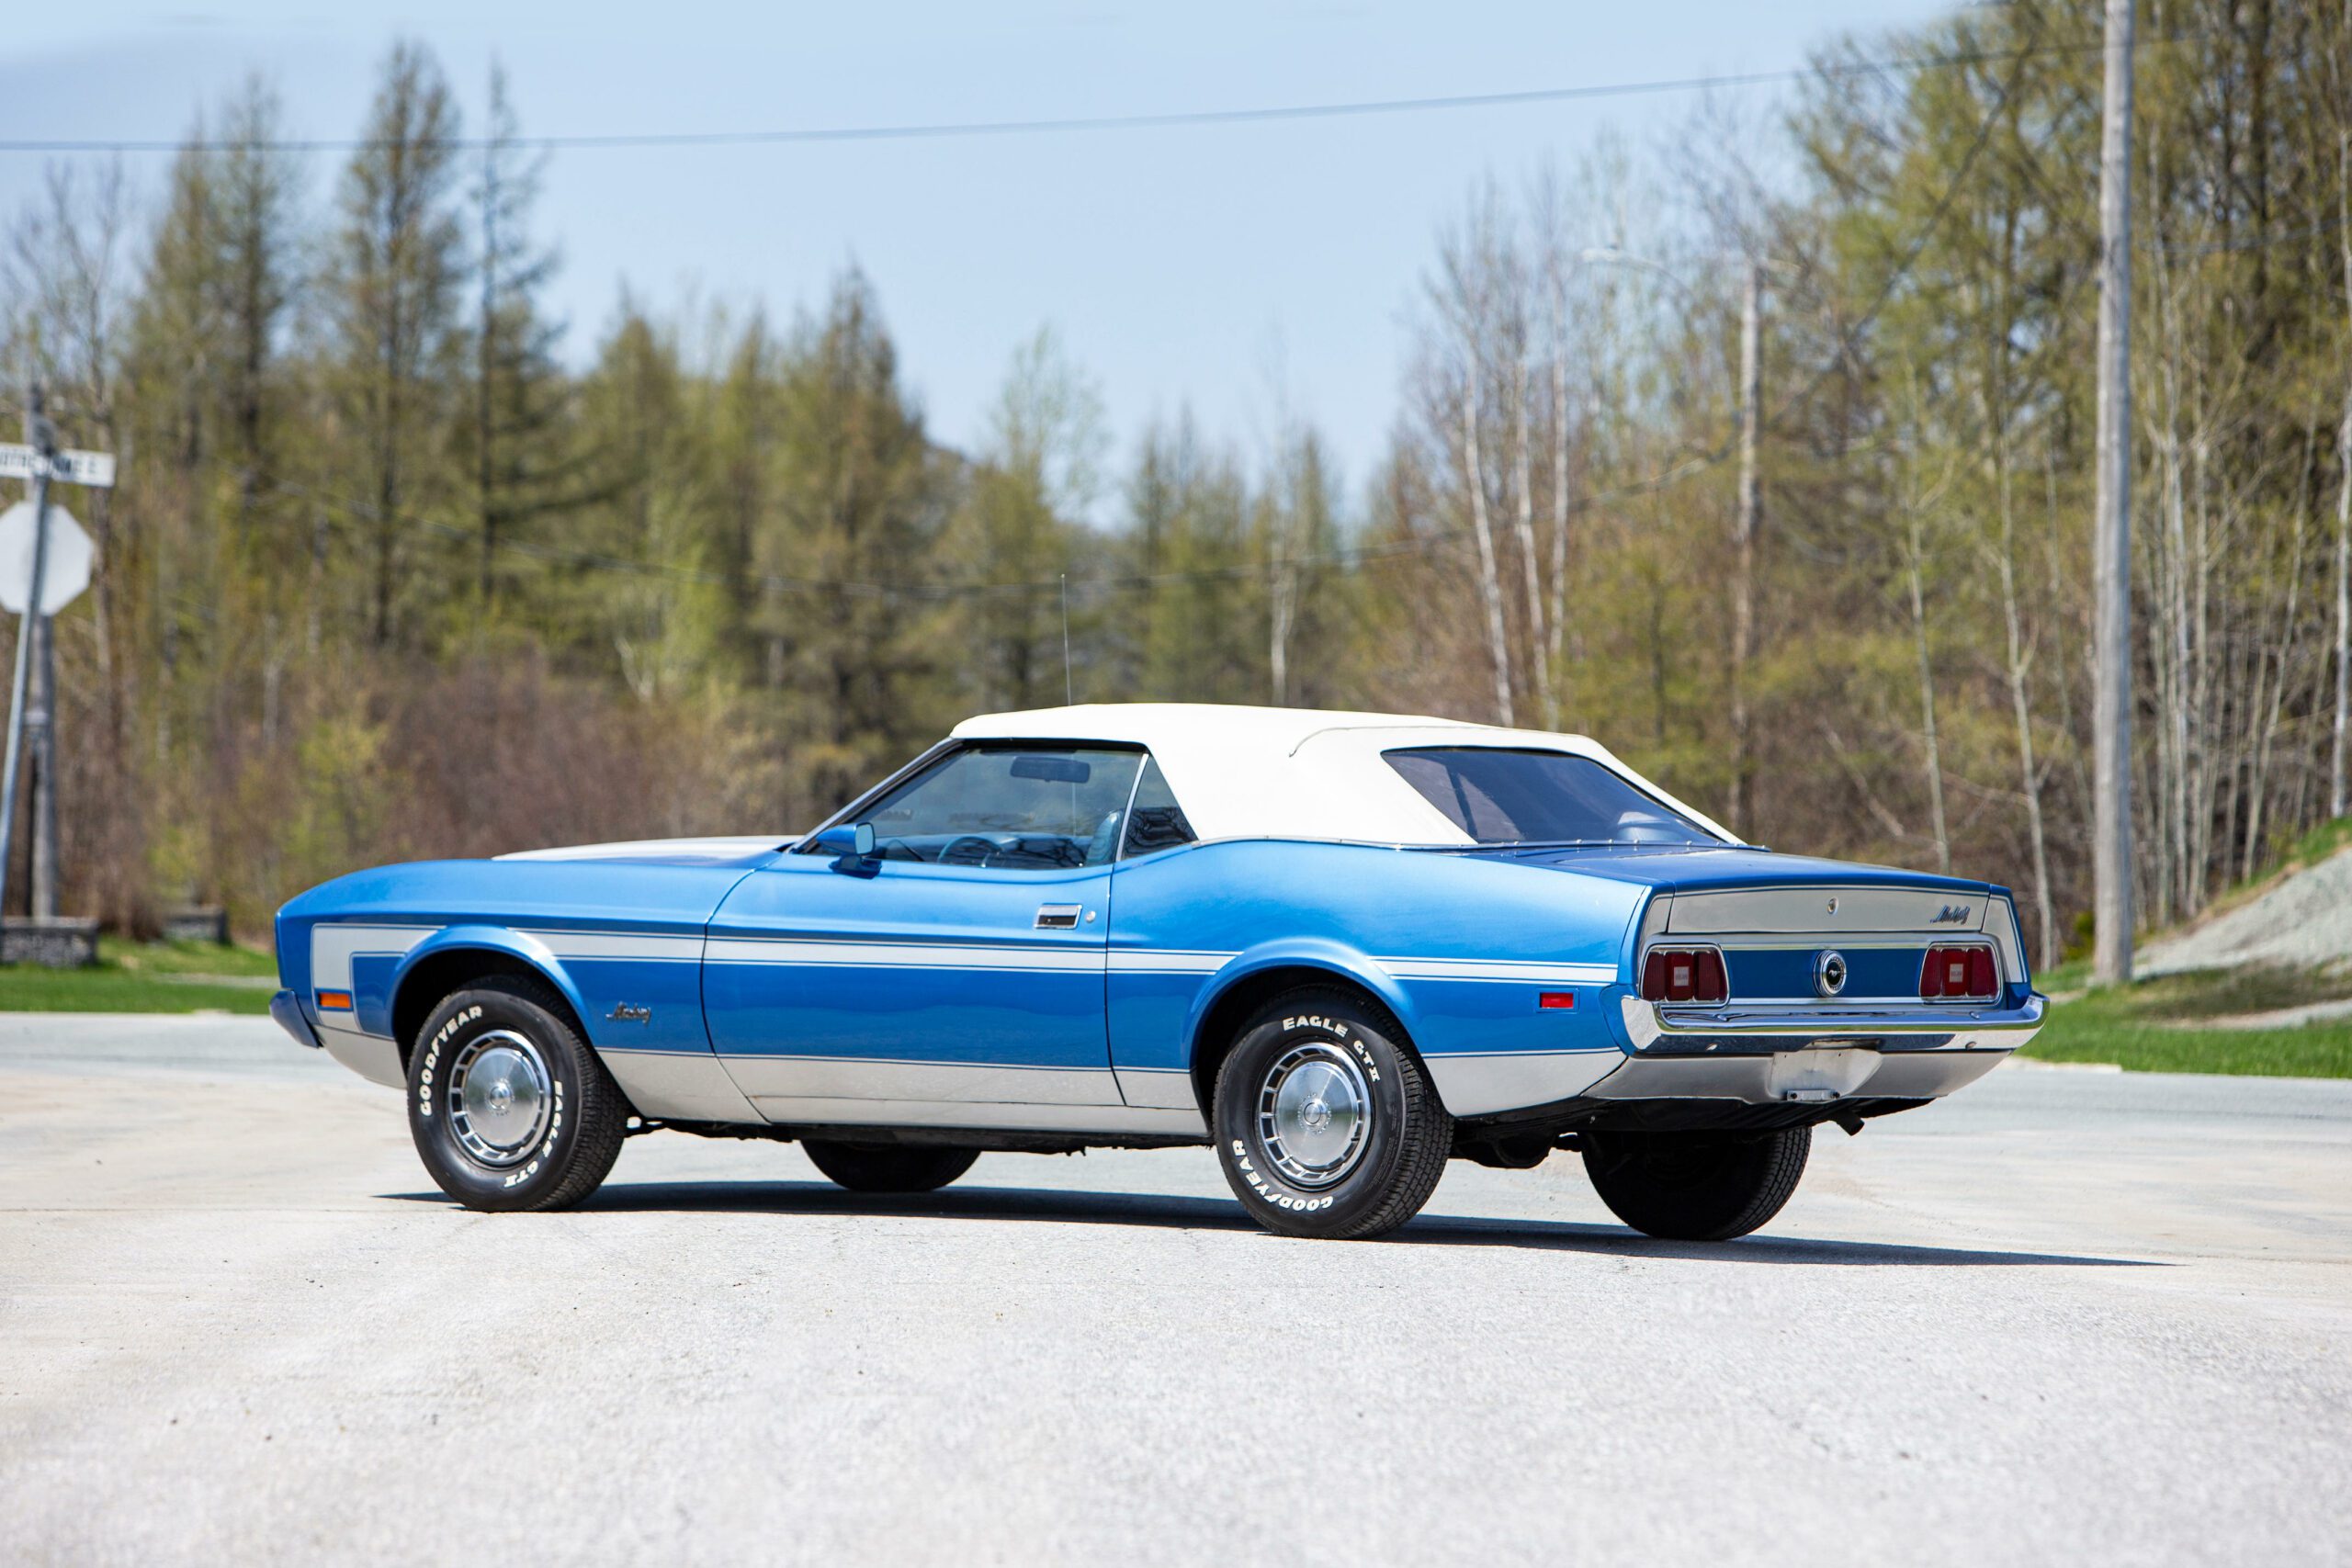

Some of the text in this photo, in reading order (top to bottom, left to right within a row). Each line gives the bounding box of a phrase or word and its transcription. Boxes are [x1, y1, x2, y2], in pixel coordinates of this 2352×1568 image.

[419, 1005, 483, 1117] GOODYEAR
[1283, 1015, 1349, 1037] EAGLE
[542, 1080, 564, 1158] EAGLE
[1231, 1139, 1334, 1212] GOODYEAR
